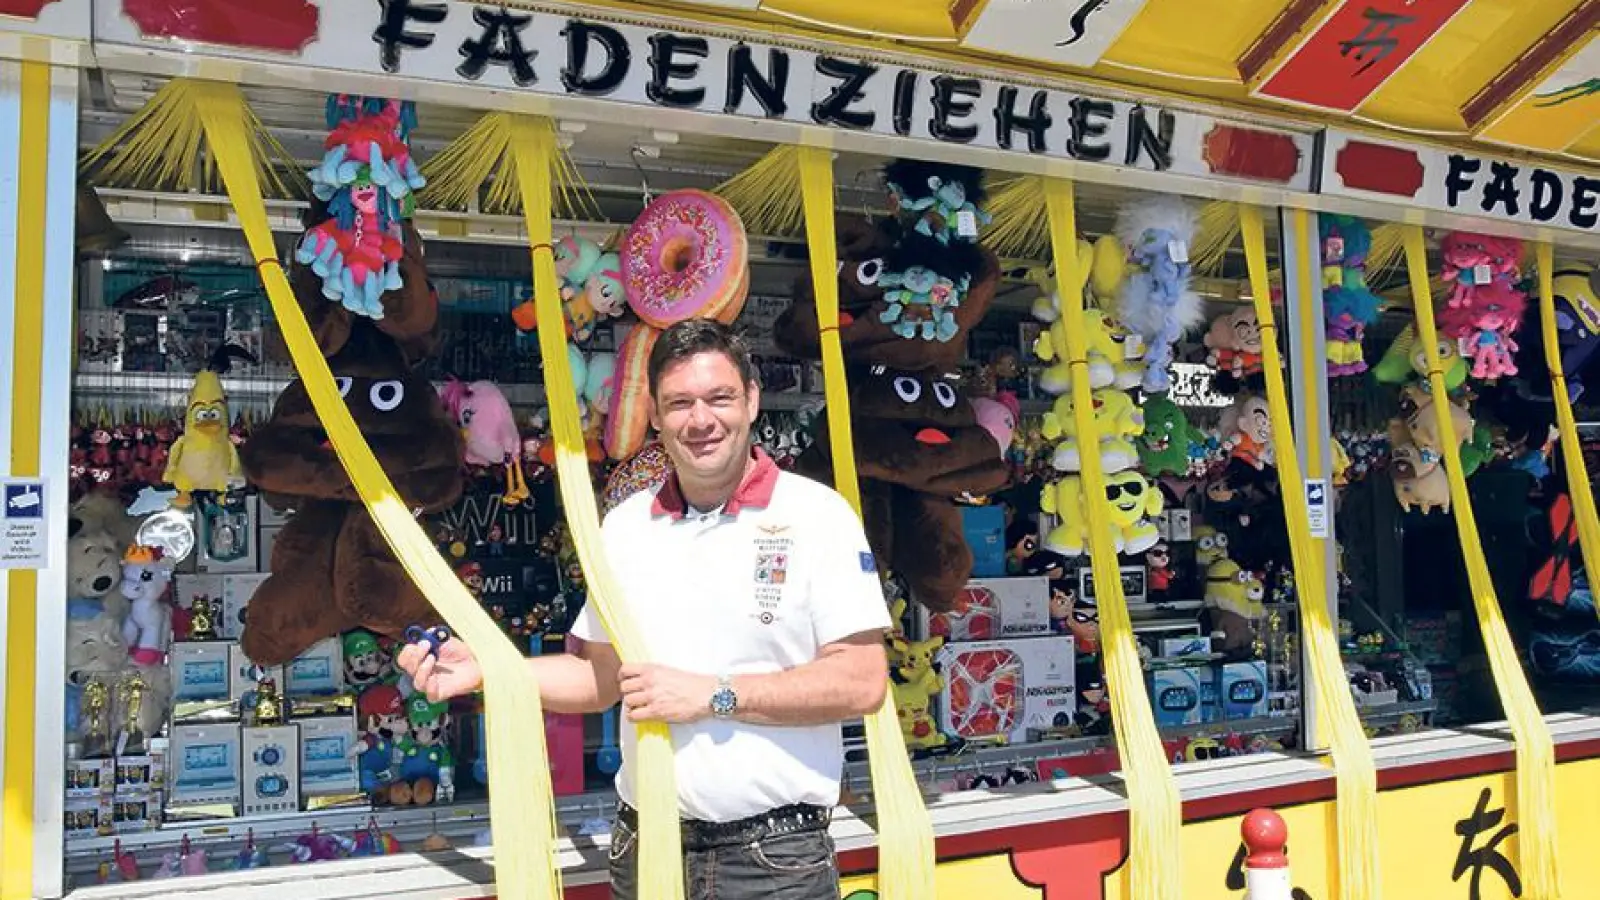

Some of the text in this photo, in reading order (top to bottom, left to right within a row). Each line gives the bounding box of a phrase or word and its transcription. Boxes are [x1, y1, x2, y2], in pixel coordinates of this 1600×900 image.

[372, 0, 1175, 171] FADENZIEHEN
[442, 494, 537, 546] Wii
[481, 575, 513, 593] Wii
